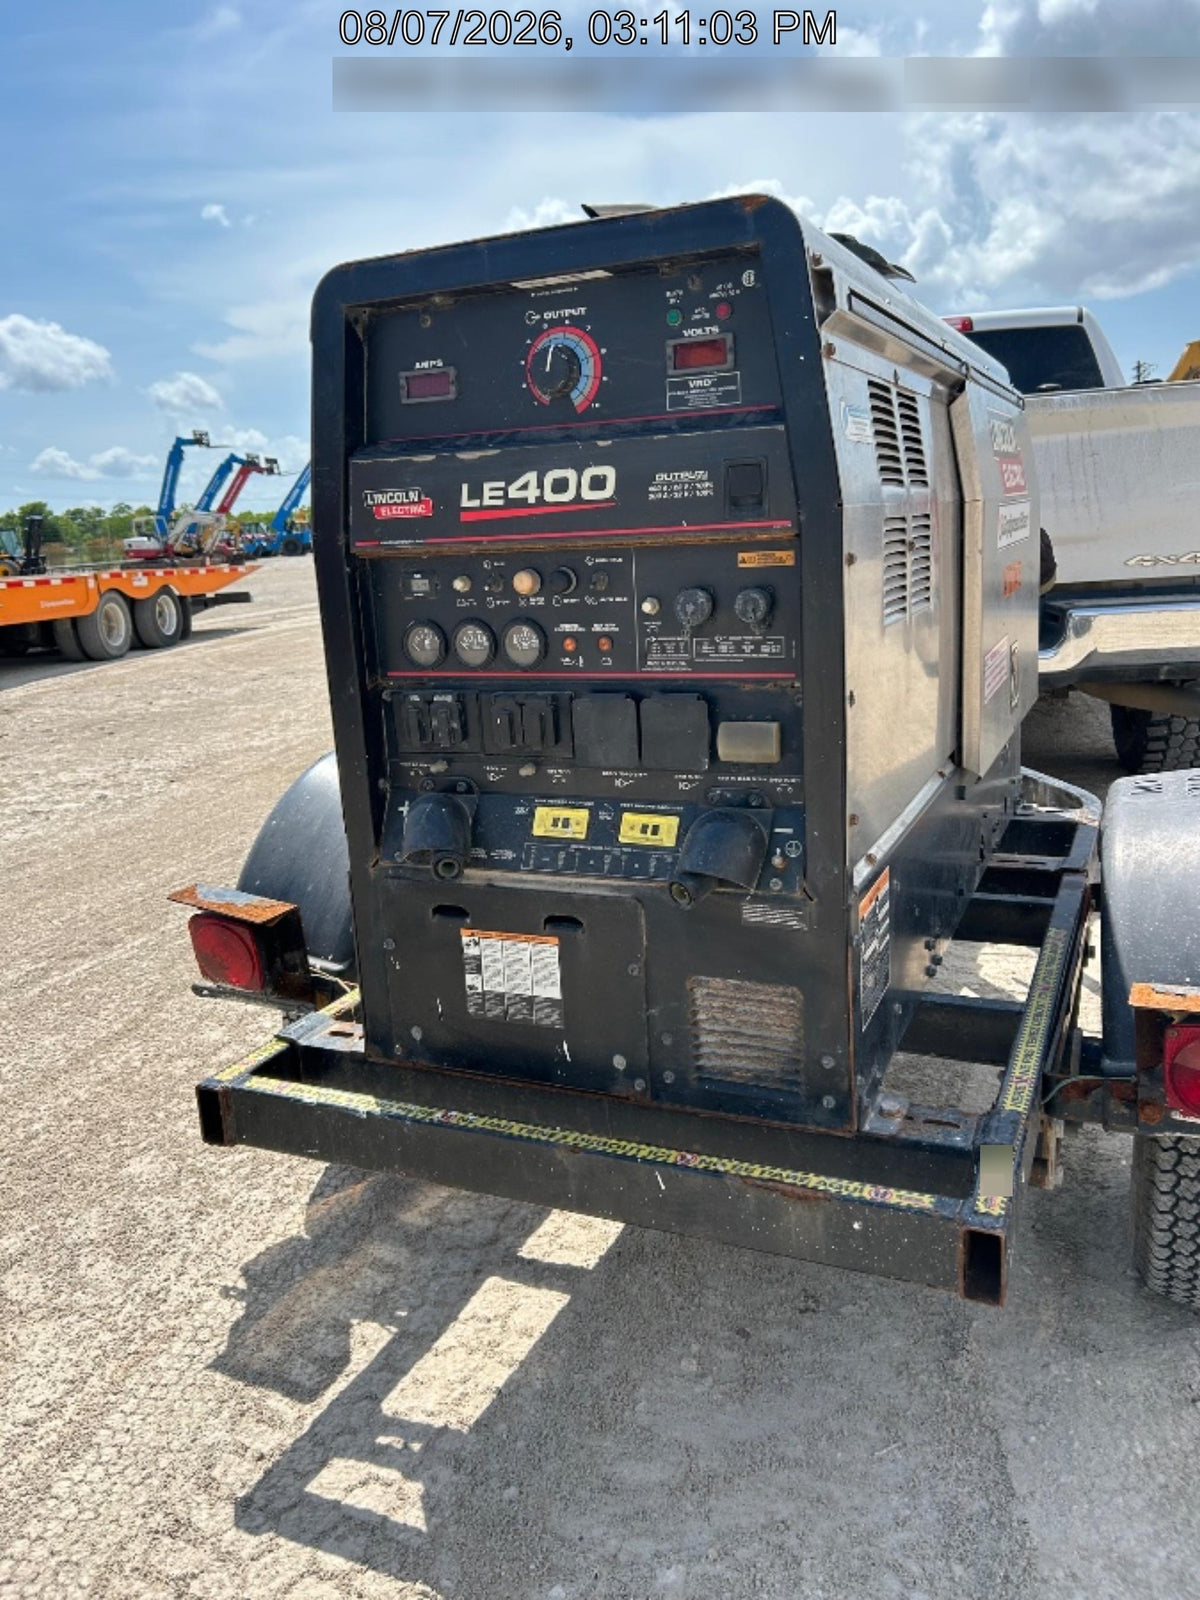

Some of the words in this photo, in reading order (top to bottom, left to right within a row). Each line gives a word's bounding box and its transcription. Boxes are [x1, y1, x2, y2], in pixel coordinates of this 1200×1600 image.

[543, 307, 587, 319] OUTPUT
[682, 325, 720, 336] VOLTS
[460, 465, 616, 507] LE400
[367, 490, 419, 505] LINCOLN
[380, 504, 426, 516] ELECTRIC
